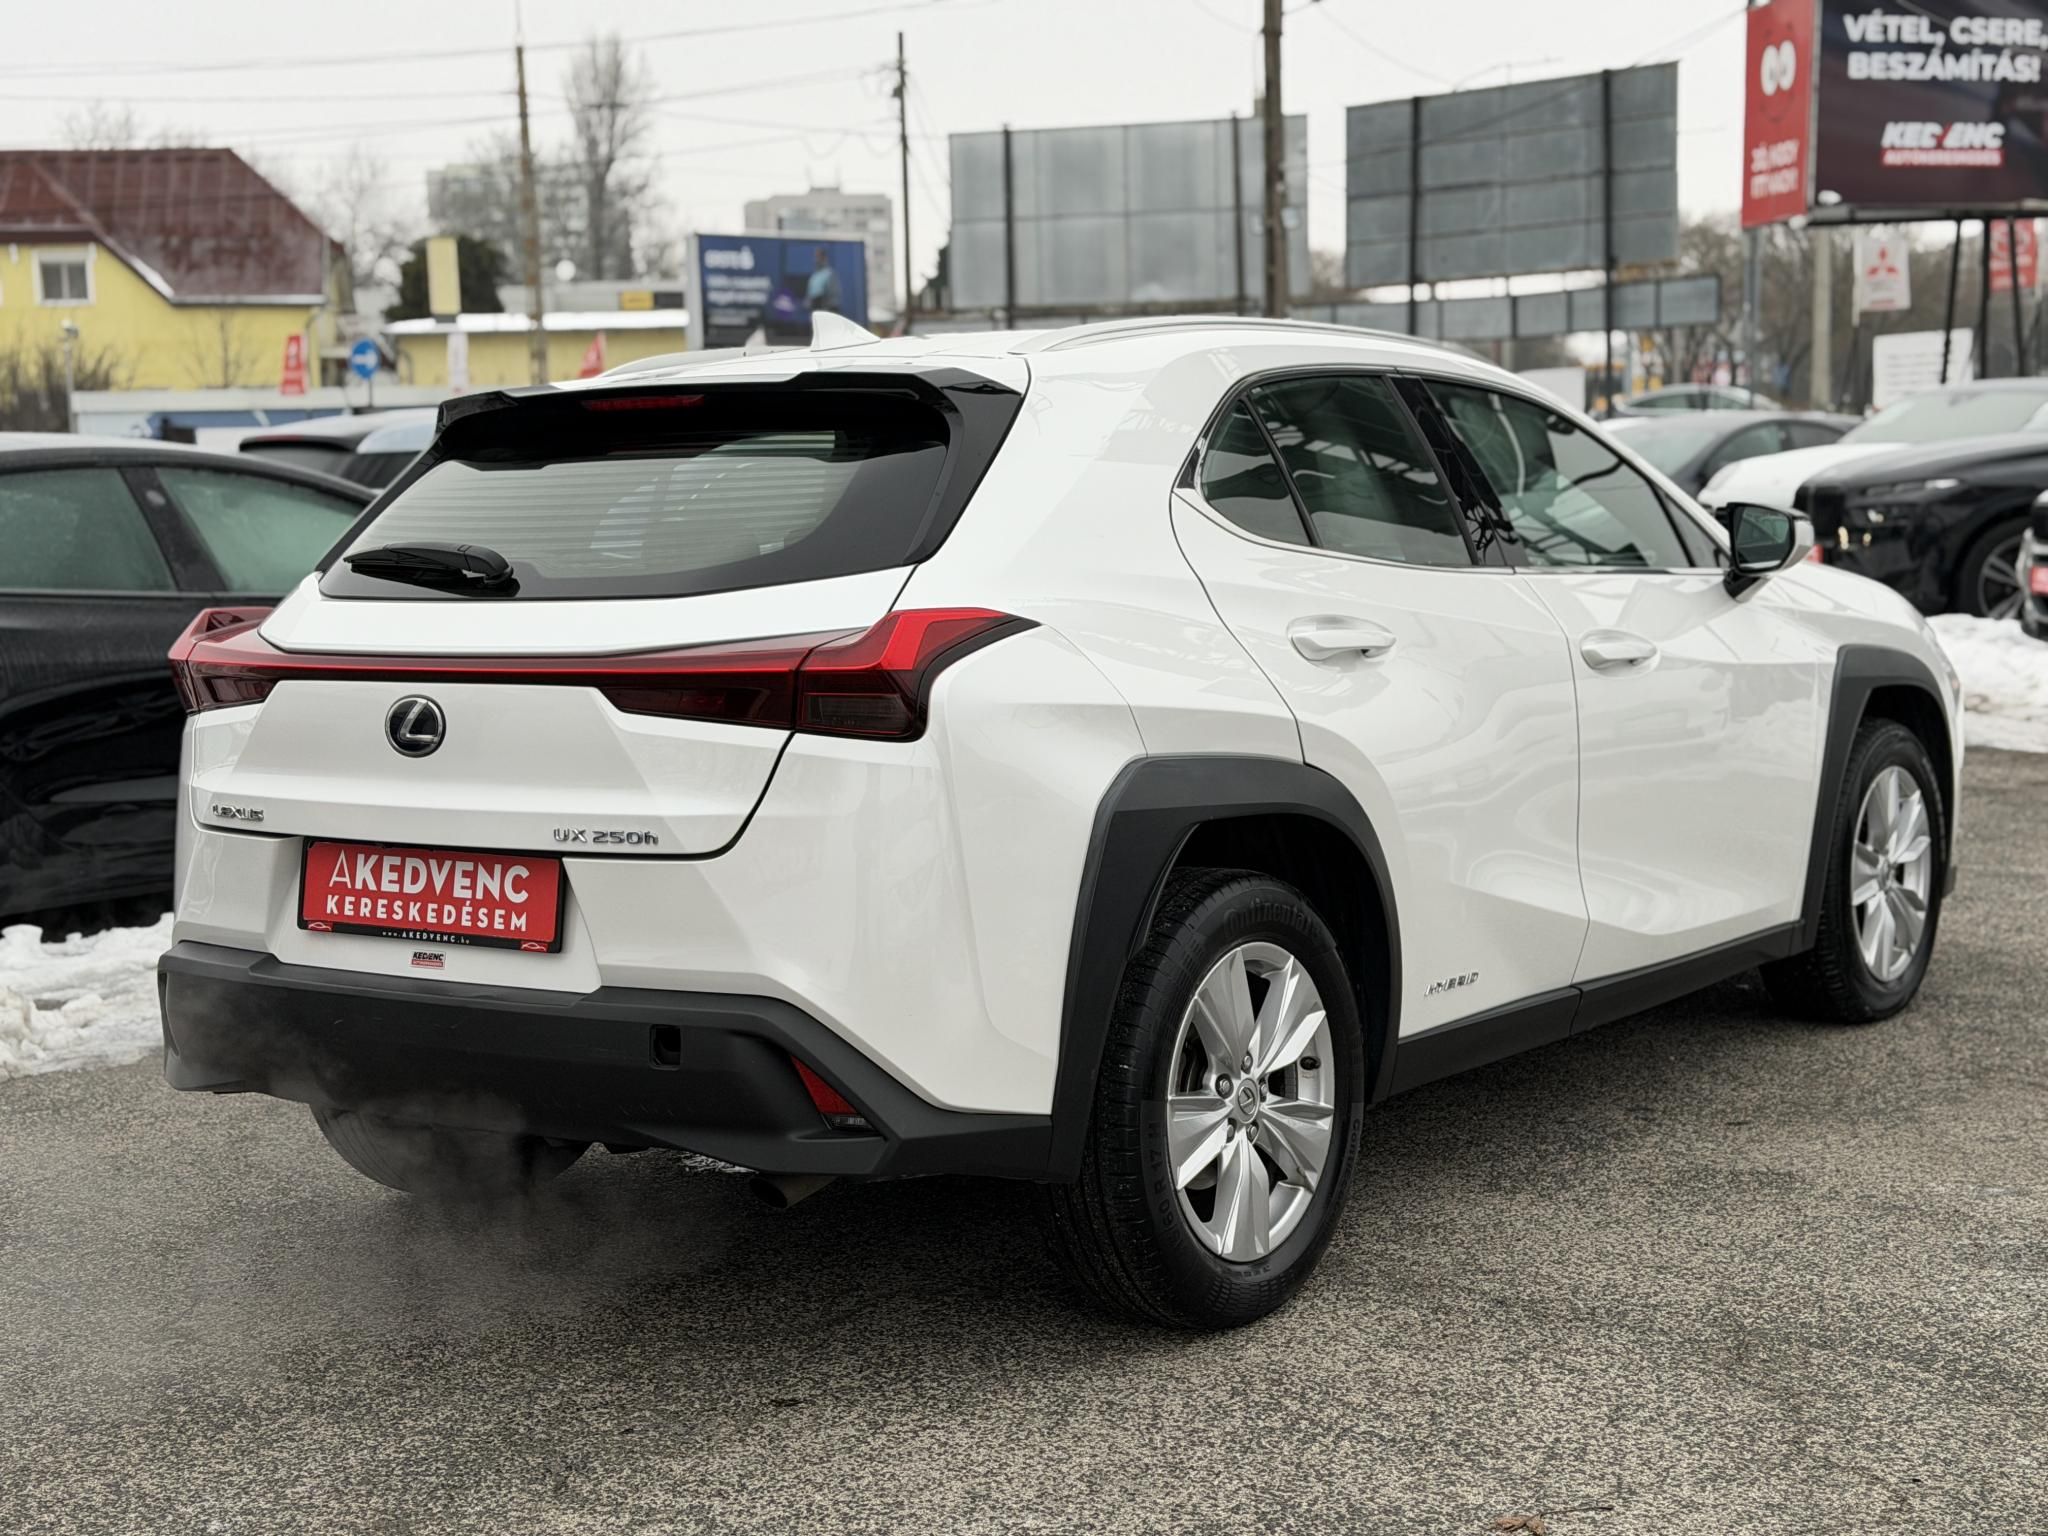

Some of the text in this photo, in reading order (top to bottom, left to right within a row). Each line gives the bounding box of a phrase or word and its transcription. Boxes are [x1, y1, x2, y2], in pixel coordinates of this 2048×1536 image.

[1843, 8, 1946, 49] VÉTEL,
[212, 804, 265, 822] LEXUS
[553, 828, 659, 846] UX 250h
[326, 894, 527, 932] KERESKEDÉSEM
